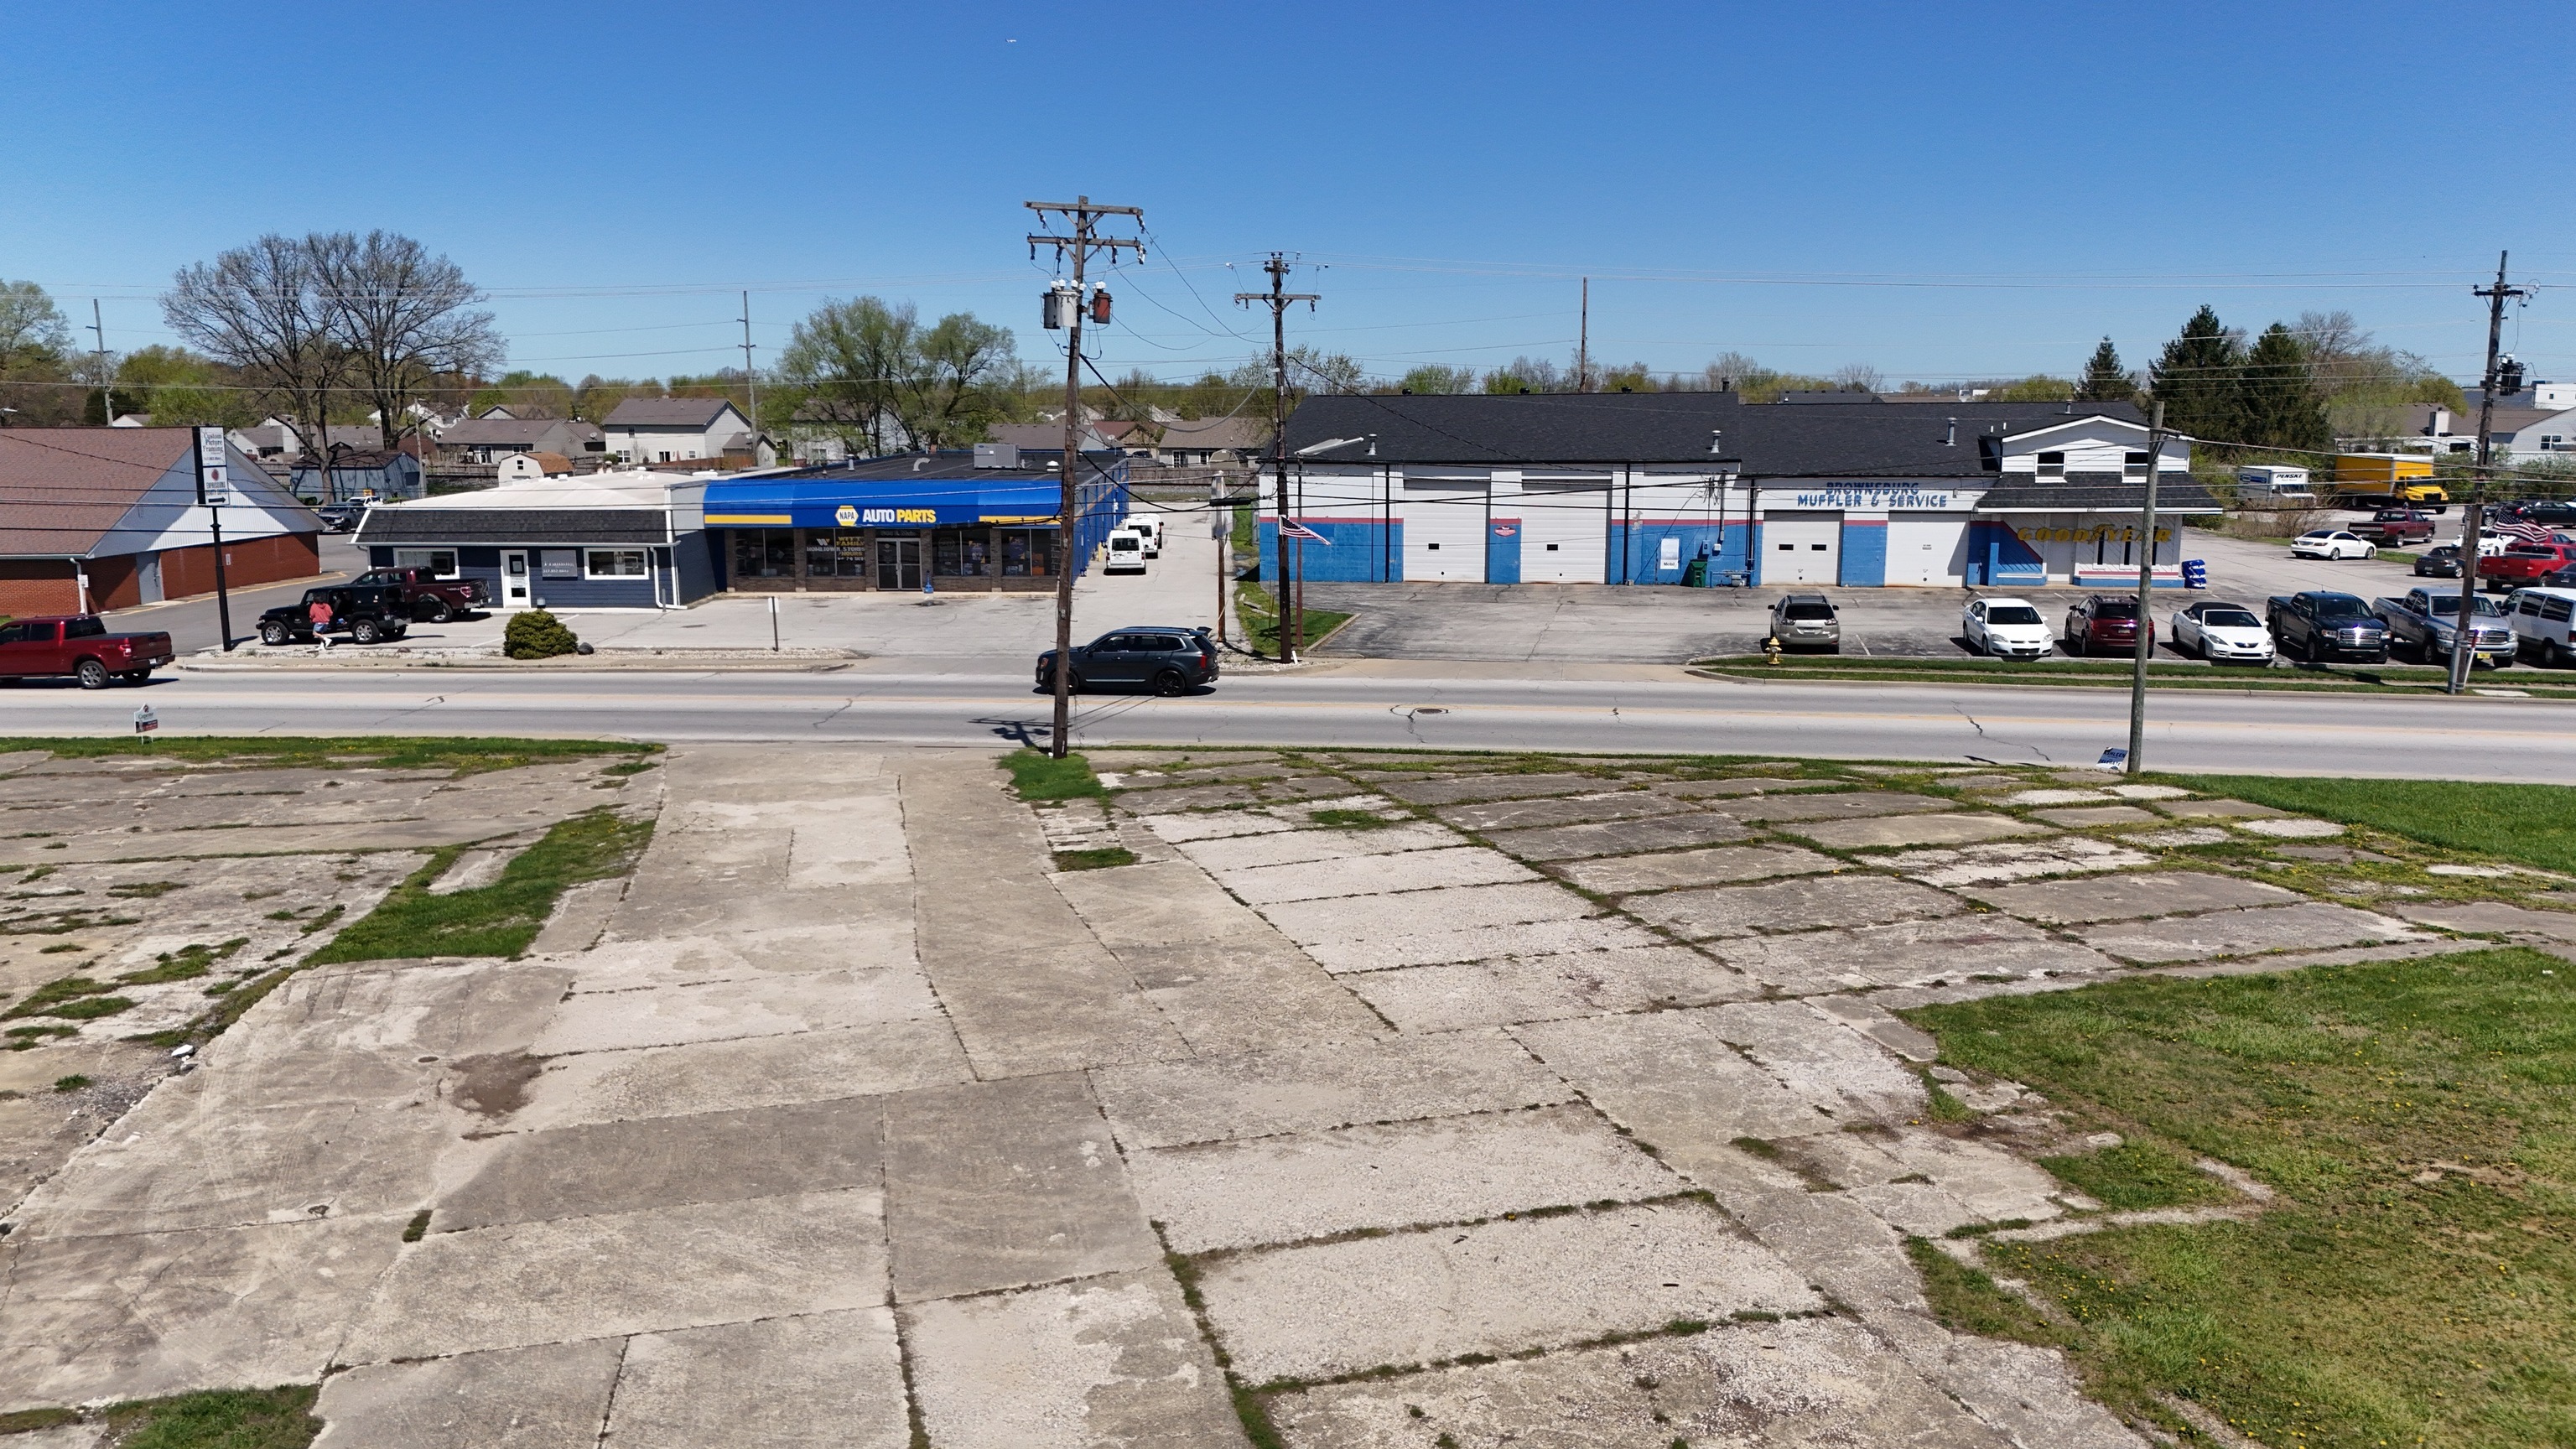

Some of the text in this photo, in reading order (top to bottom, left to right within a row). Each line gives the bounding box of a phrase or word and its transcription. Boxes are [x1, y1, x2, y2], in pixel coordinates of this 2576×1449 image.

[1826, 482, 1919, 496] BROWNSBURG
[1797, 495, 1947, 507] MUFFLER & SERVICE
[839, 509, 937, 523] NAPA AUTO PARTS
[2017, 526, 2173, 543] GOODYER
